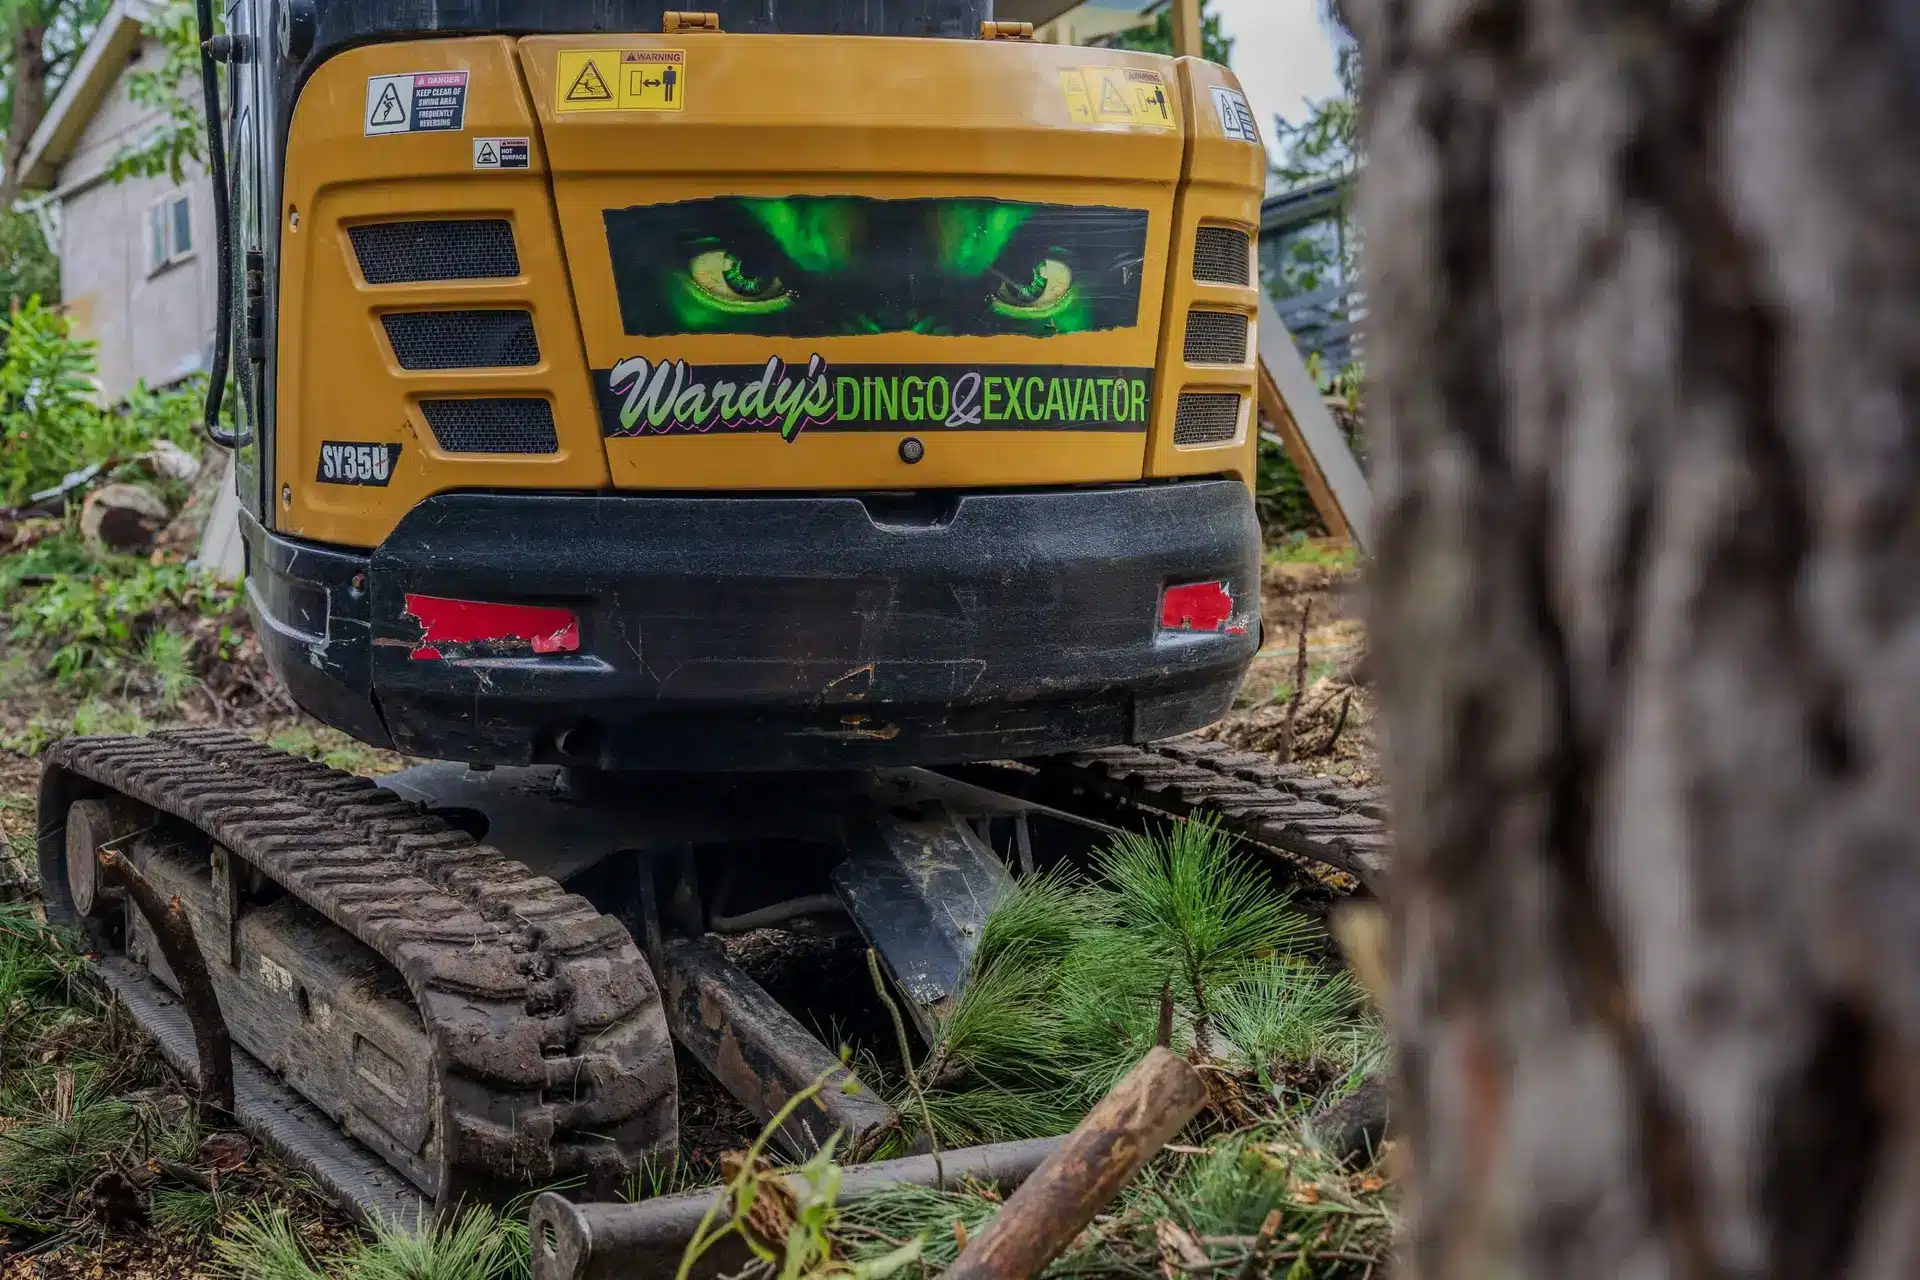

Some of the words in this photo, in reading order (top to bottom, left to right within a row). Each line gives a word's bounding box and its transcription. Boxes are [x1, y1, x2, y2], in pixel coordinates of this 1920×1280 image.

[637, 53, 680, 61] WARNING
[427, 76, 460, 84] DANGER
[432, 88, 450, 96] CLEAR
[440, 97, 457, 105] AREA
[419, 109, 454, 118] FREQUENTLY
[420, 119, 451, 127] REVERSING
[609, 353, 834, 440] Wardy's
[837, 376, 949, 421] DINGO
[984, 376, 1146, 422] EXCAVATOR
[322, 444, 389, 481] SY35U
